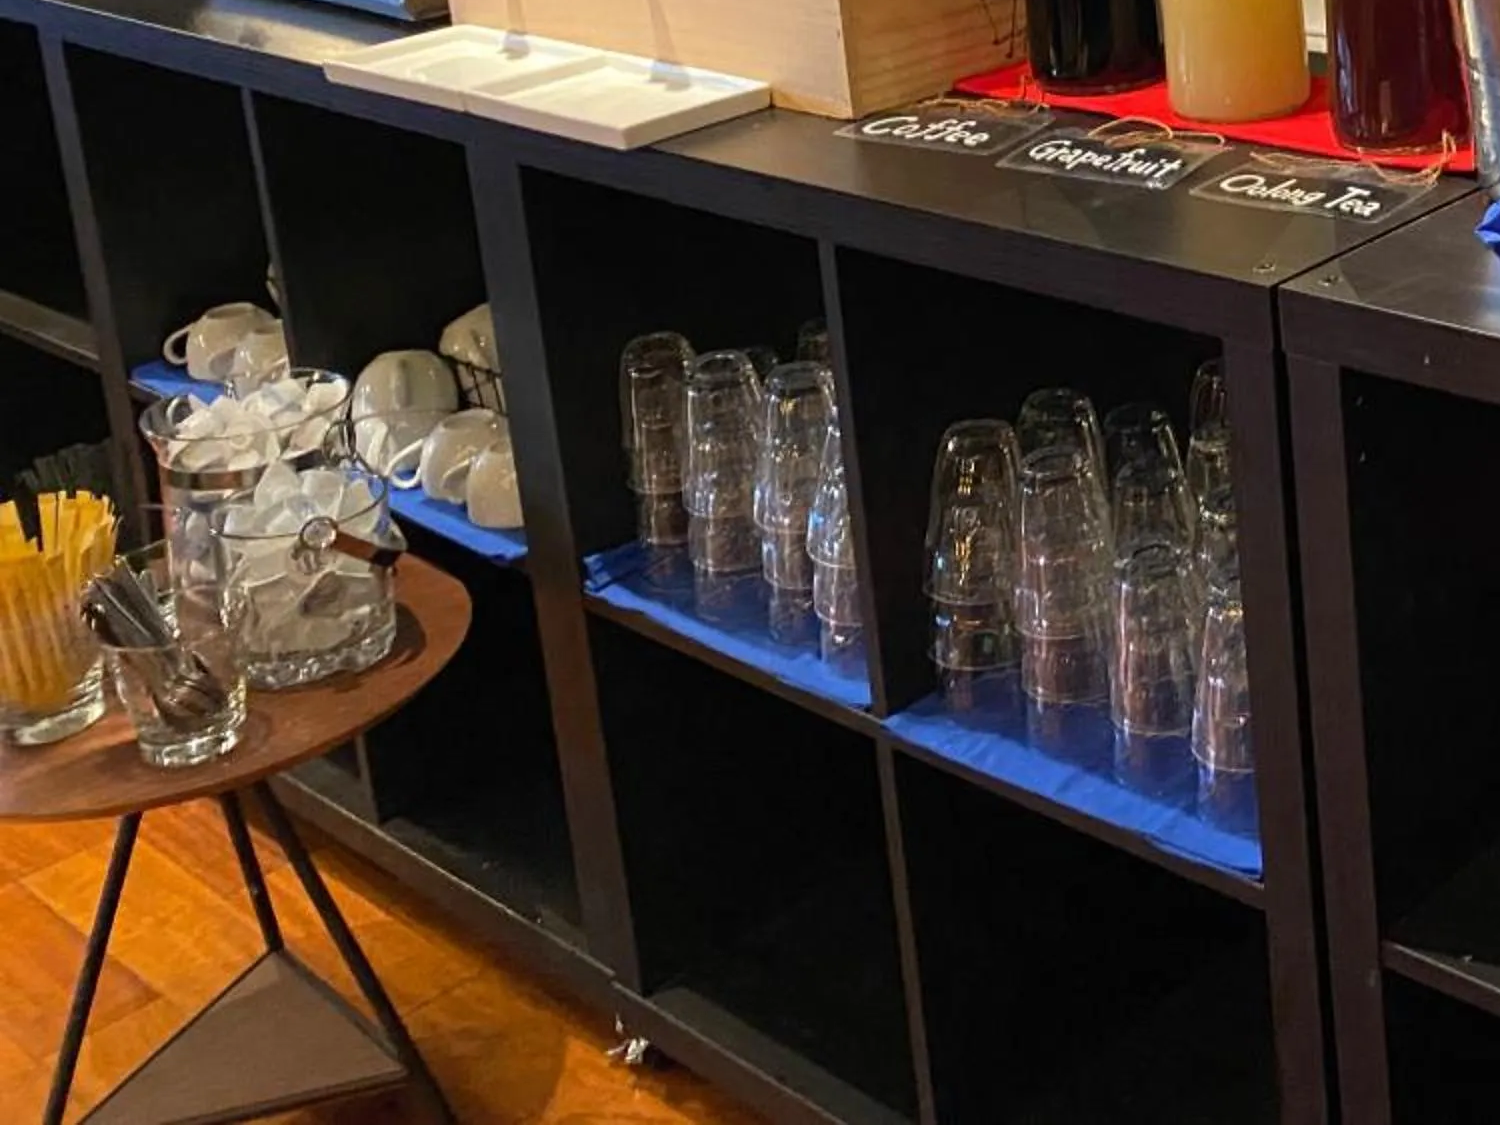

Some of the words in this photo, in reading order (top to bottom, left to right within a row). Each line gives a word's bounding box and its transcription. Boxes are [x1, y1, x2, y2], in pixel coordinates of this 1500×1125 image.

[862, 116, 990, 147] Coffee
[1029, 140, 1183, 177] Grapefruit
[1324, 187, 1381, 216] Tea
